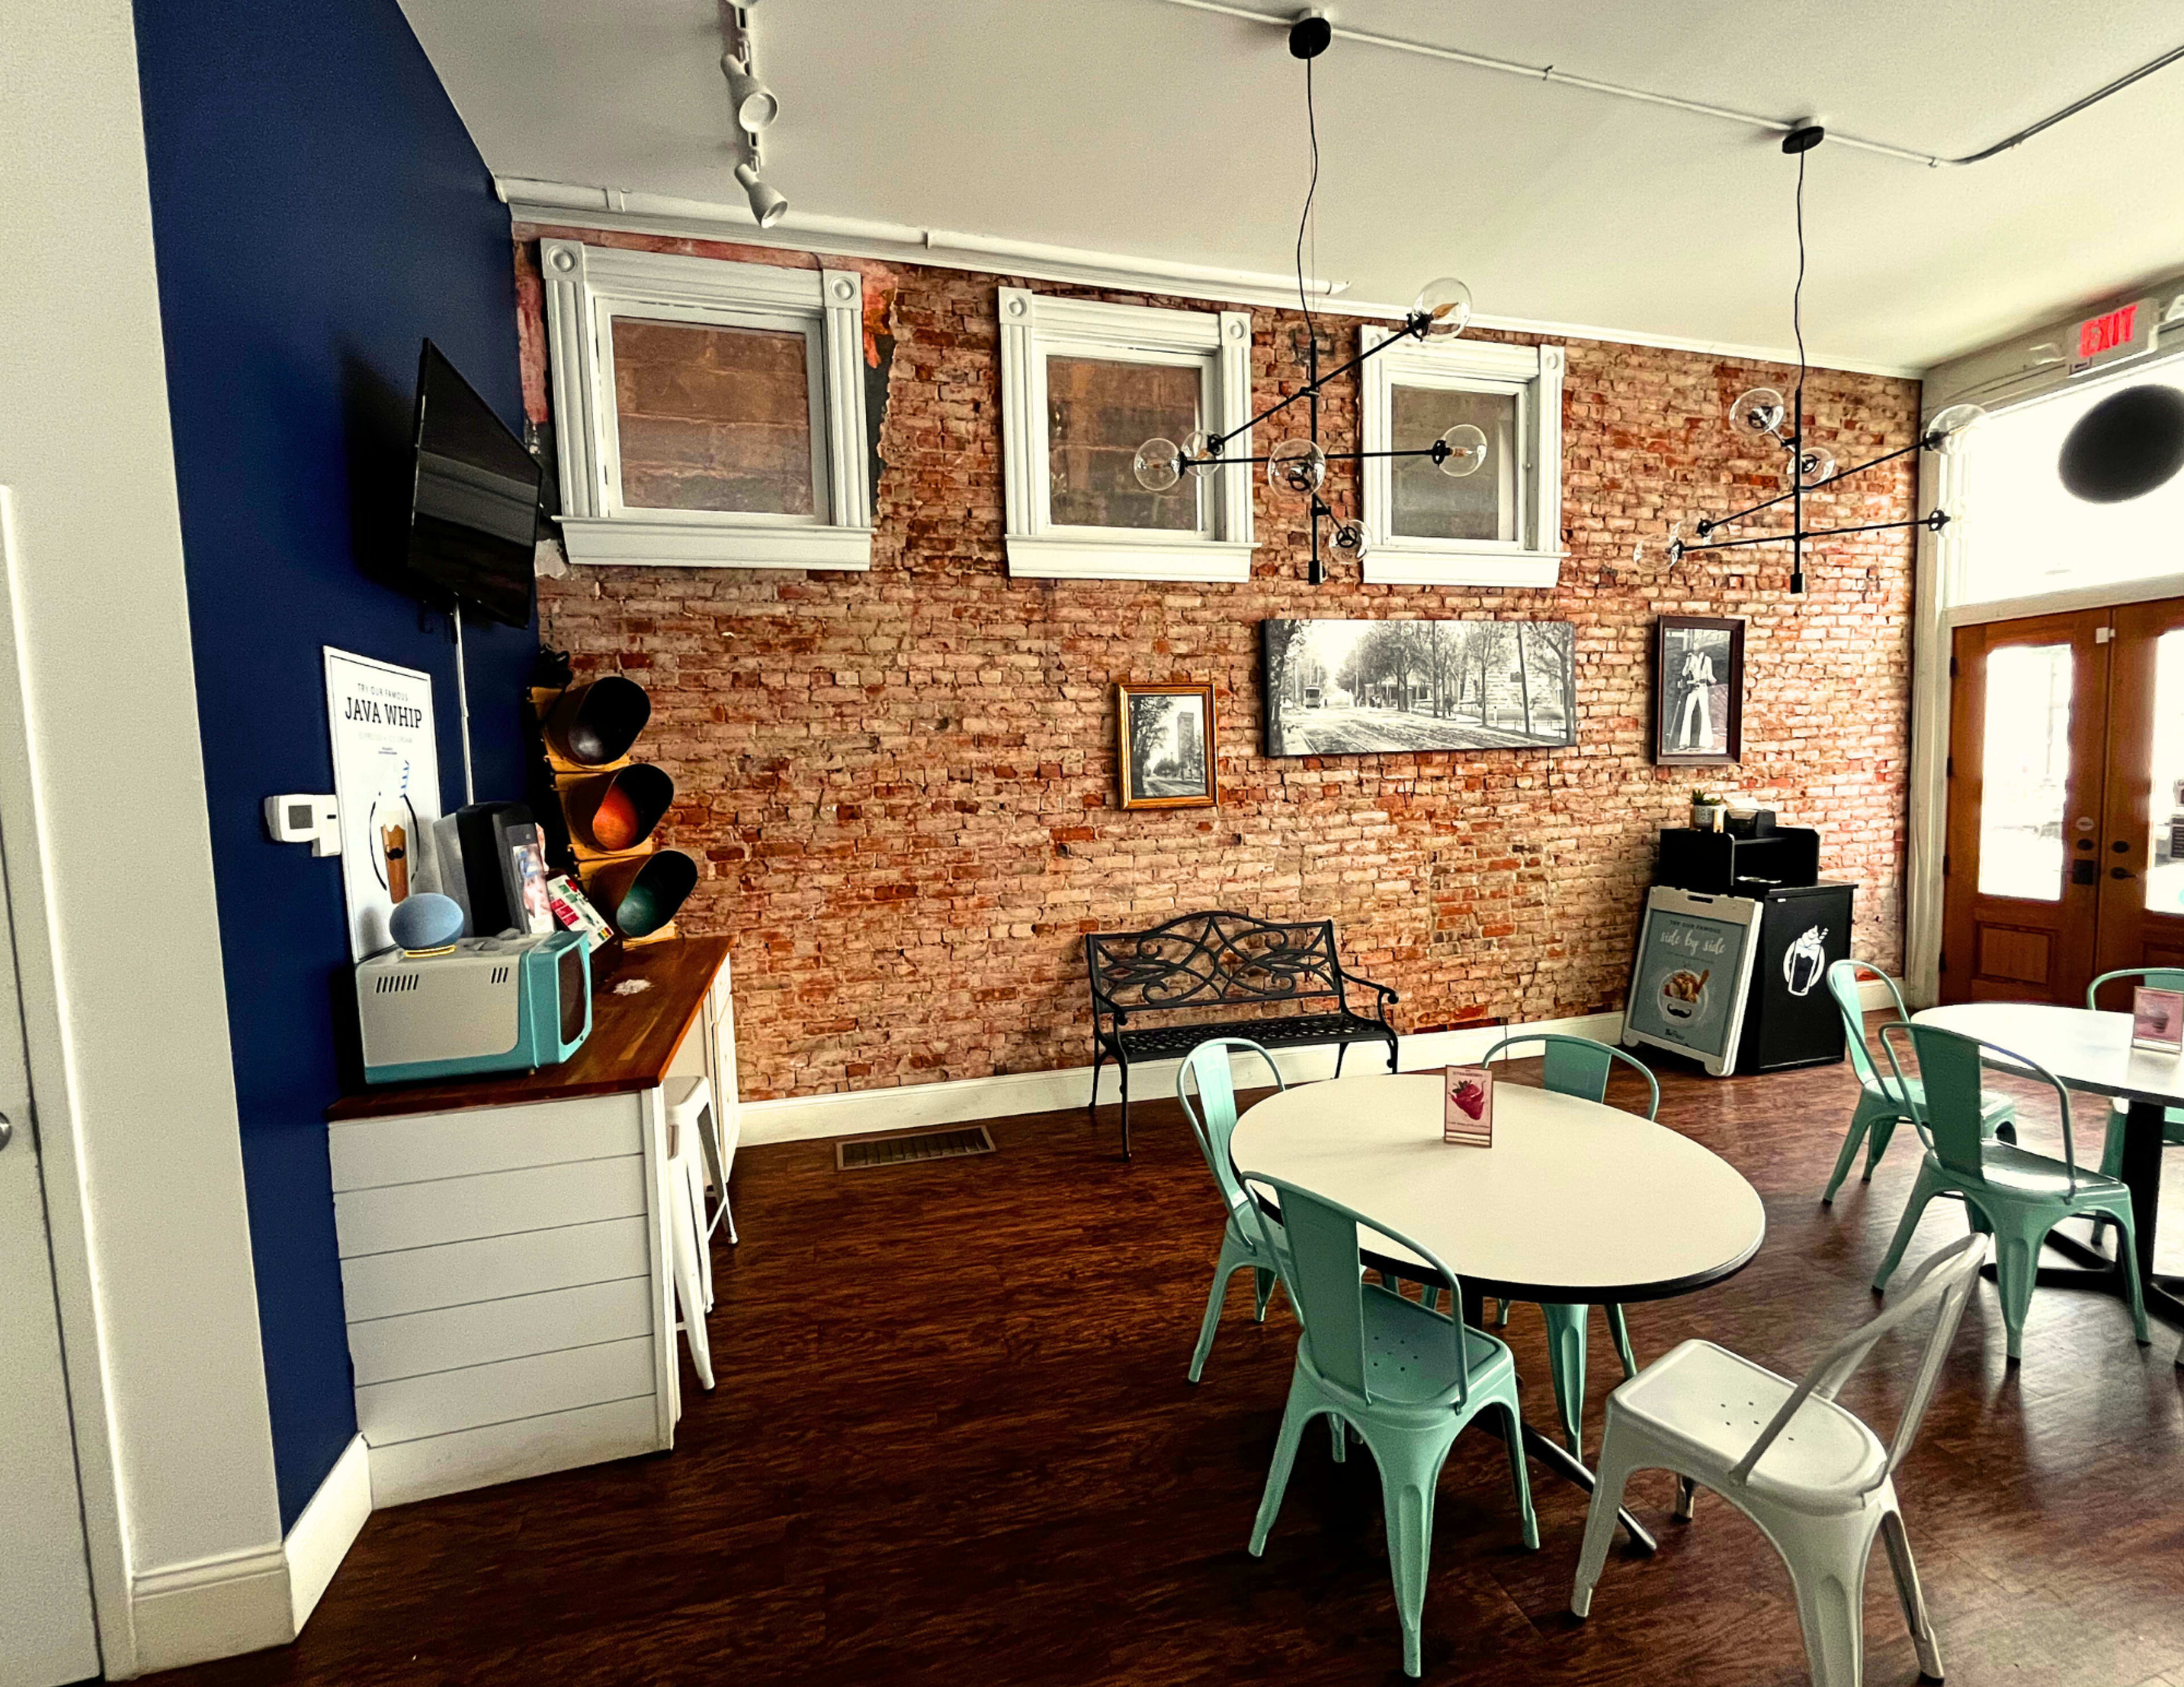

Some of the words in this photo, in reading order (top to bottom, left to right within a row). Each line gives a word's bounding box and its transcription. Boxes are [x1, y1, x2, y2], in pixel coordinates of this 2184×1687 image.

[2079, 305, 2137, 358] EXIT
[345, 697, 382, 724] JAVA
[384, 704, 422, 729] WHIP
[1660, 929, 1681, 946] side
[1684, 929, 1699, 956] by
[1702, 937, 1727, 955] side
